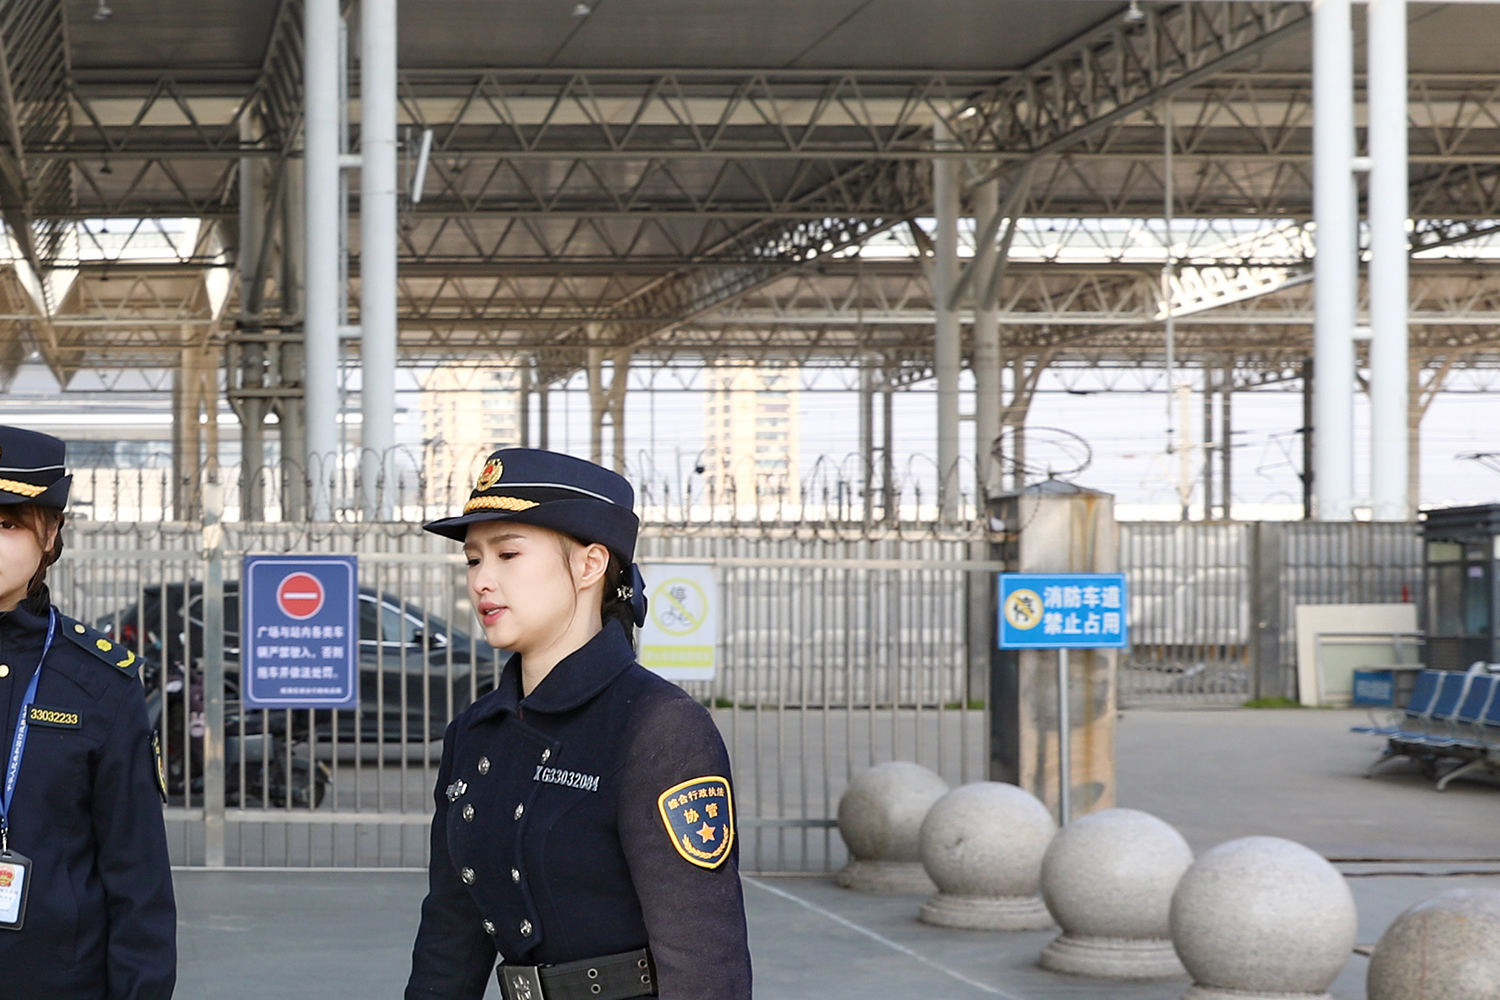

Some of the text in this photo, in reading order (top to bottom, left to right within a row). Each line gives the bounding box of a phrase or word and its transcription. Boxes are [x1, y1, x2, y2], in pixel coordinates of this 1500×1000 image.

[1043, 585, 1121, 608] 消防车道
[1043, 612, 1121, 635] 禁止占用
[30, 708, 79, 725] 33032233
[667, 786, 725, 810] 综合行政执法
[683, 802, 719, 825] 协管
